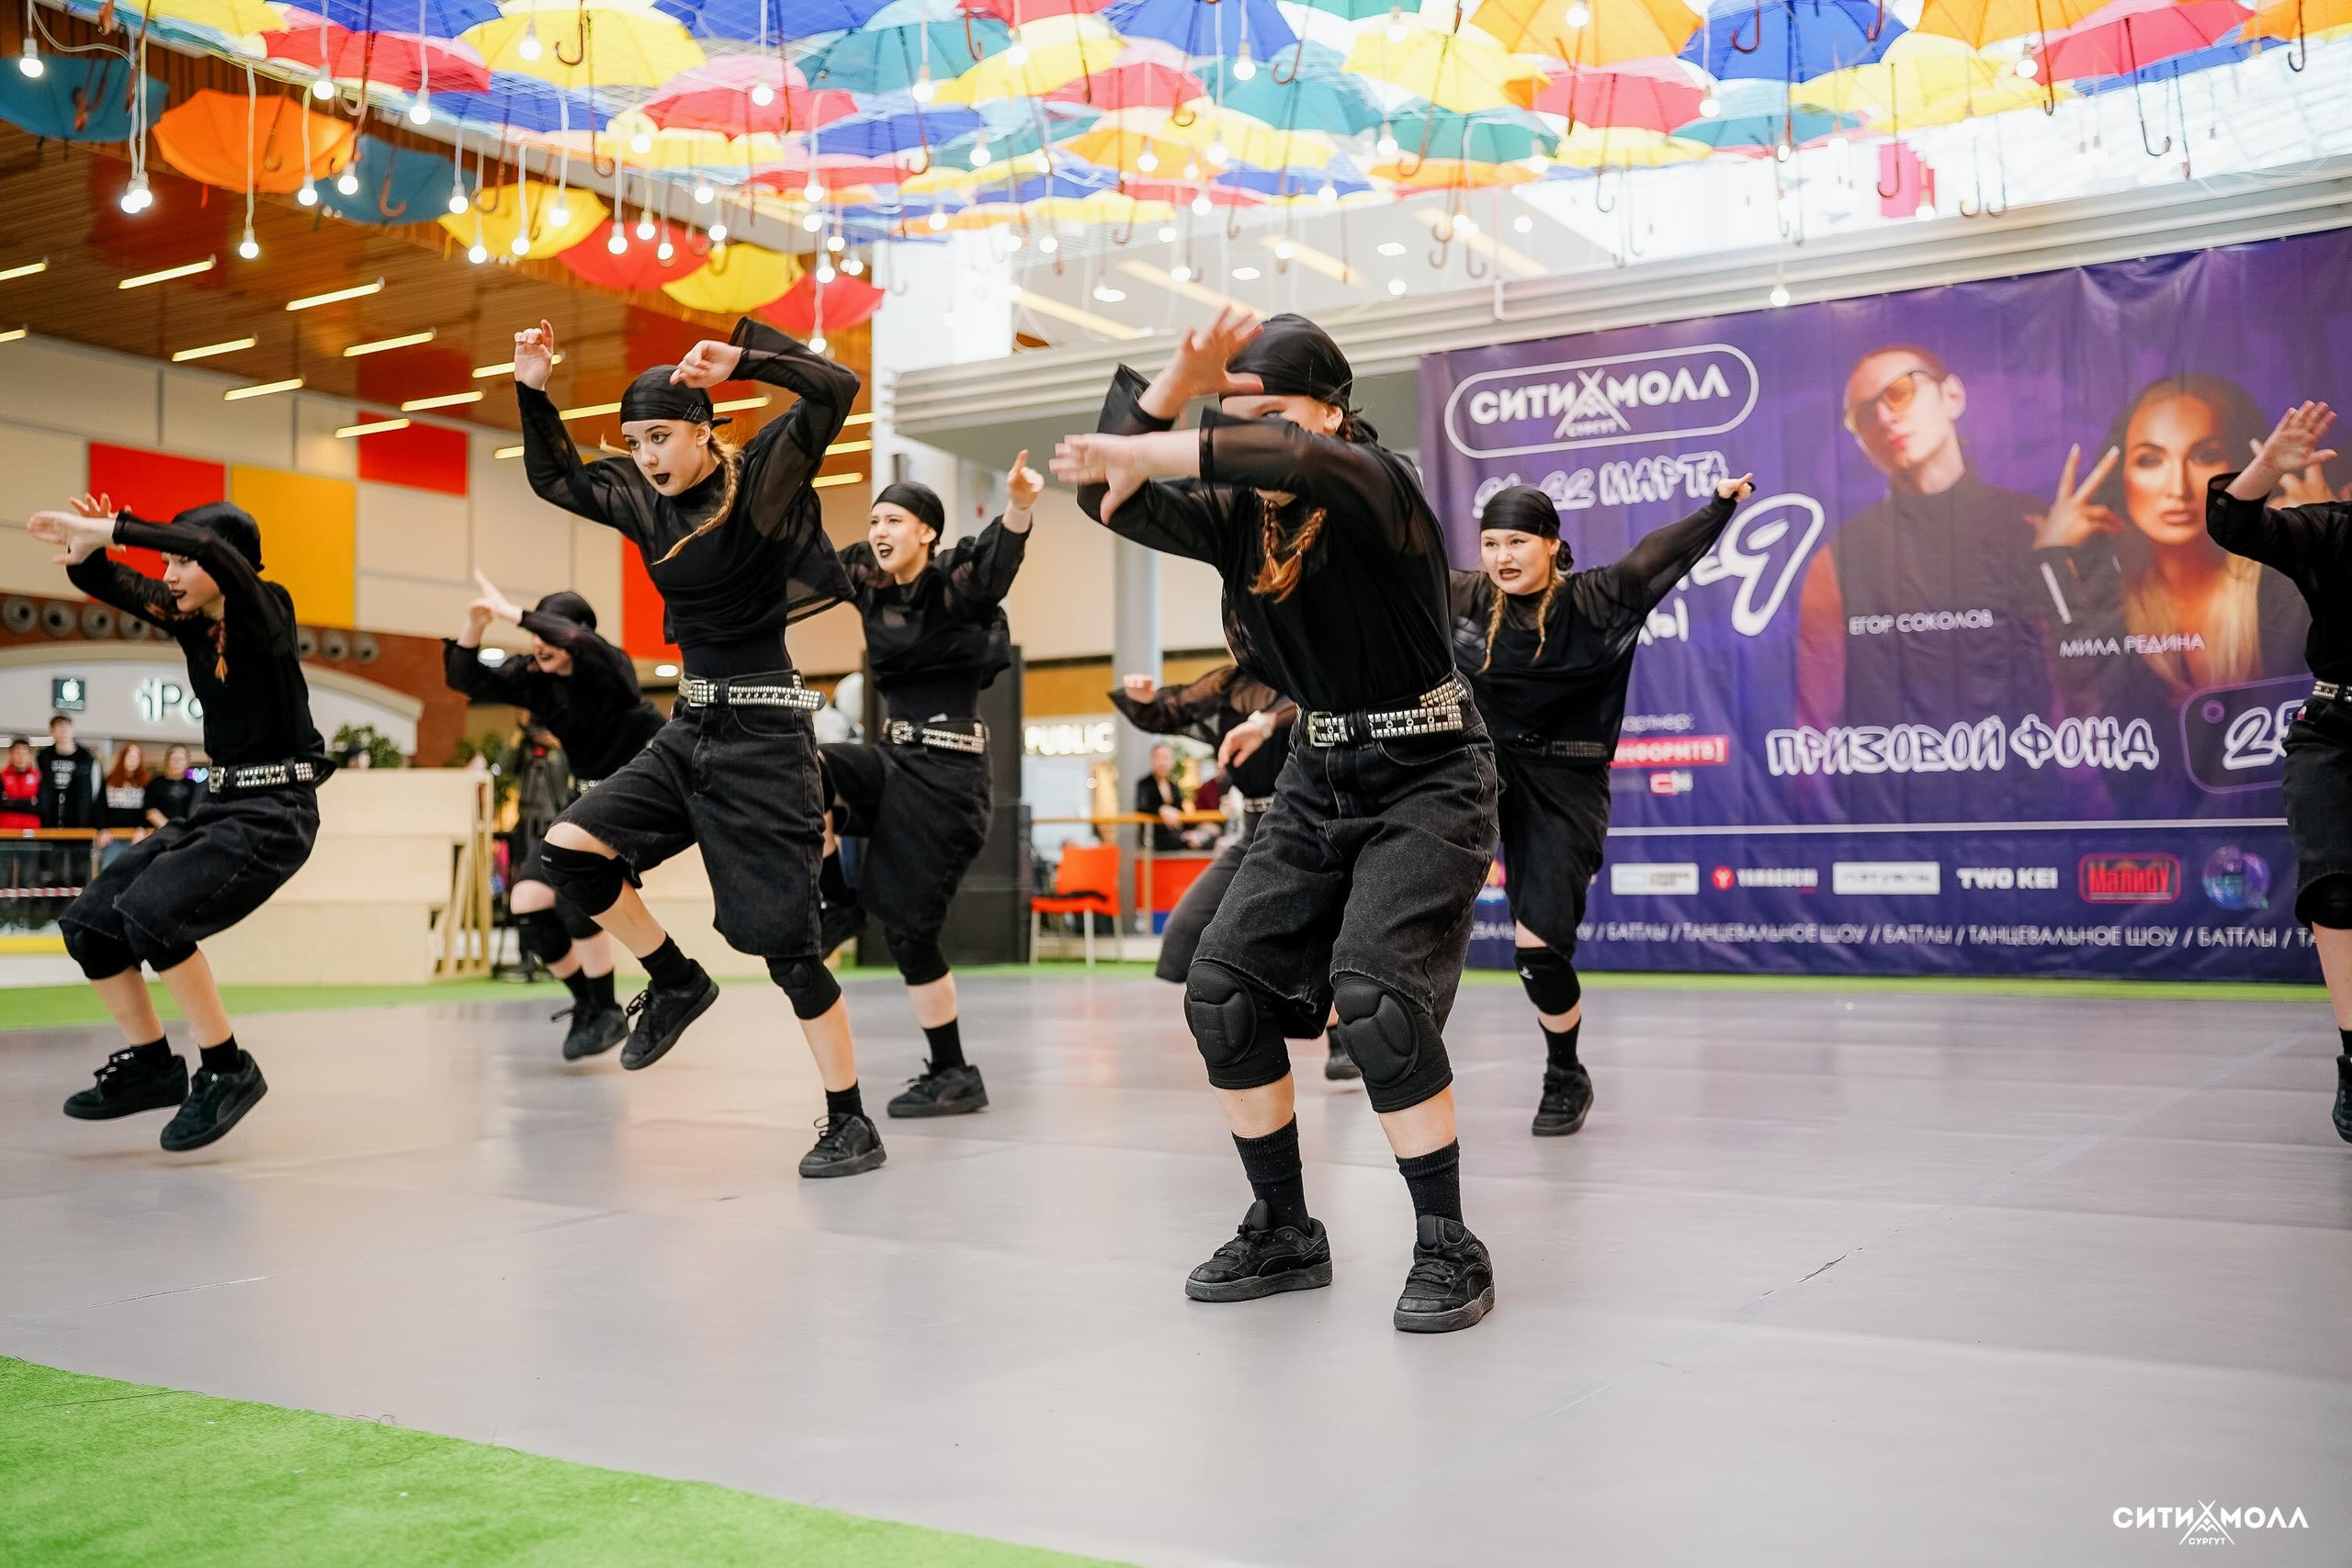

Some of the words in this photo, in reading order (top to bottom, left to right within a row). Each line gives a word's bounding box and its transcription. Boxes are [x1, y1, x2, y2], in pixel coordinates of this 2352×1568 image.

[1470, 380, 1577, 425] СИТИ
[1605, 364, 1731, 408] МОЛЛ
[1600, 450, 1729, 505] МАРТА
[1849, 615, 1894, 636] ЕГОР
[1896, 608, 1995, 633] СОКОЛОВ
[2059, 637, 2120, 658] МИЛА
[2124, 632, 2205, 655] РЕДИНА
[1765, 716, 2006, 777] ПРИЗОВОЙ
[2009, 714, 2160, 772] ФОНД
[1956, 867, 2015, 889] TWO
[2017, 867, 2058, 889] KEI
[1820, 922, 1867, 944] ШОУ
[1883, 924, 1953, 945] БАТТЛЫ
[1967, 924, 2121, 947] ТАНЦЕВАЛЬНОЕ
[2125, 926, 2178, 947] ШОУ
[2197, 927, 2277, 948] БАТТЛЫ
